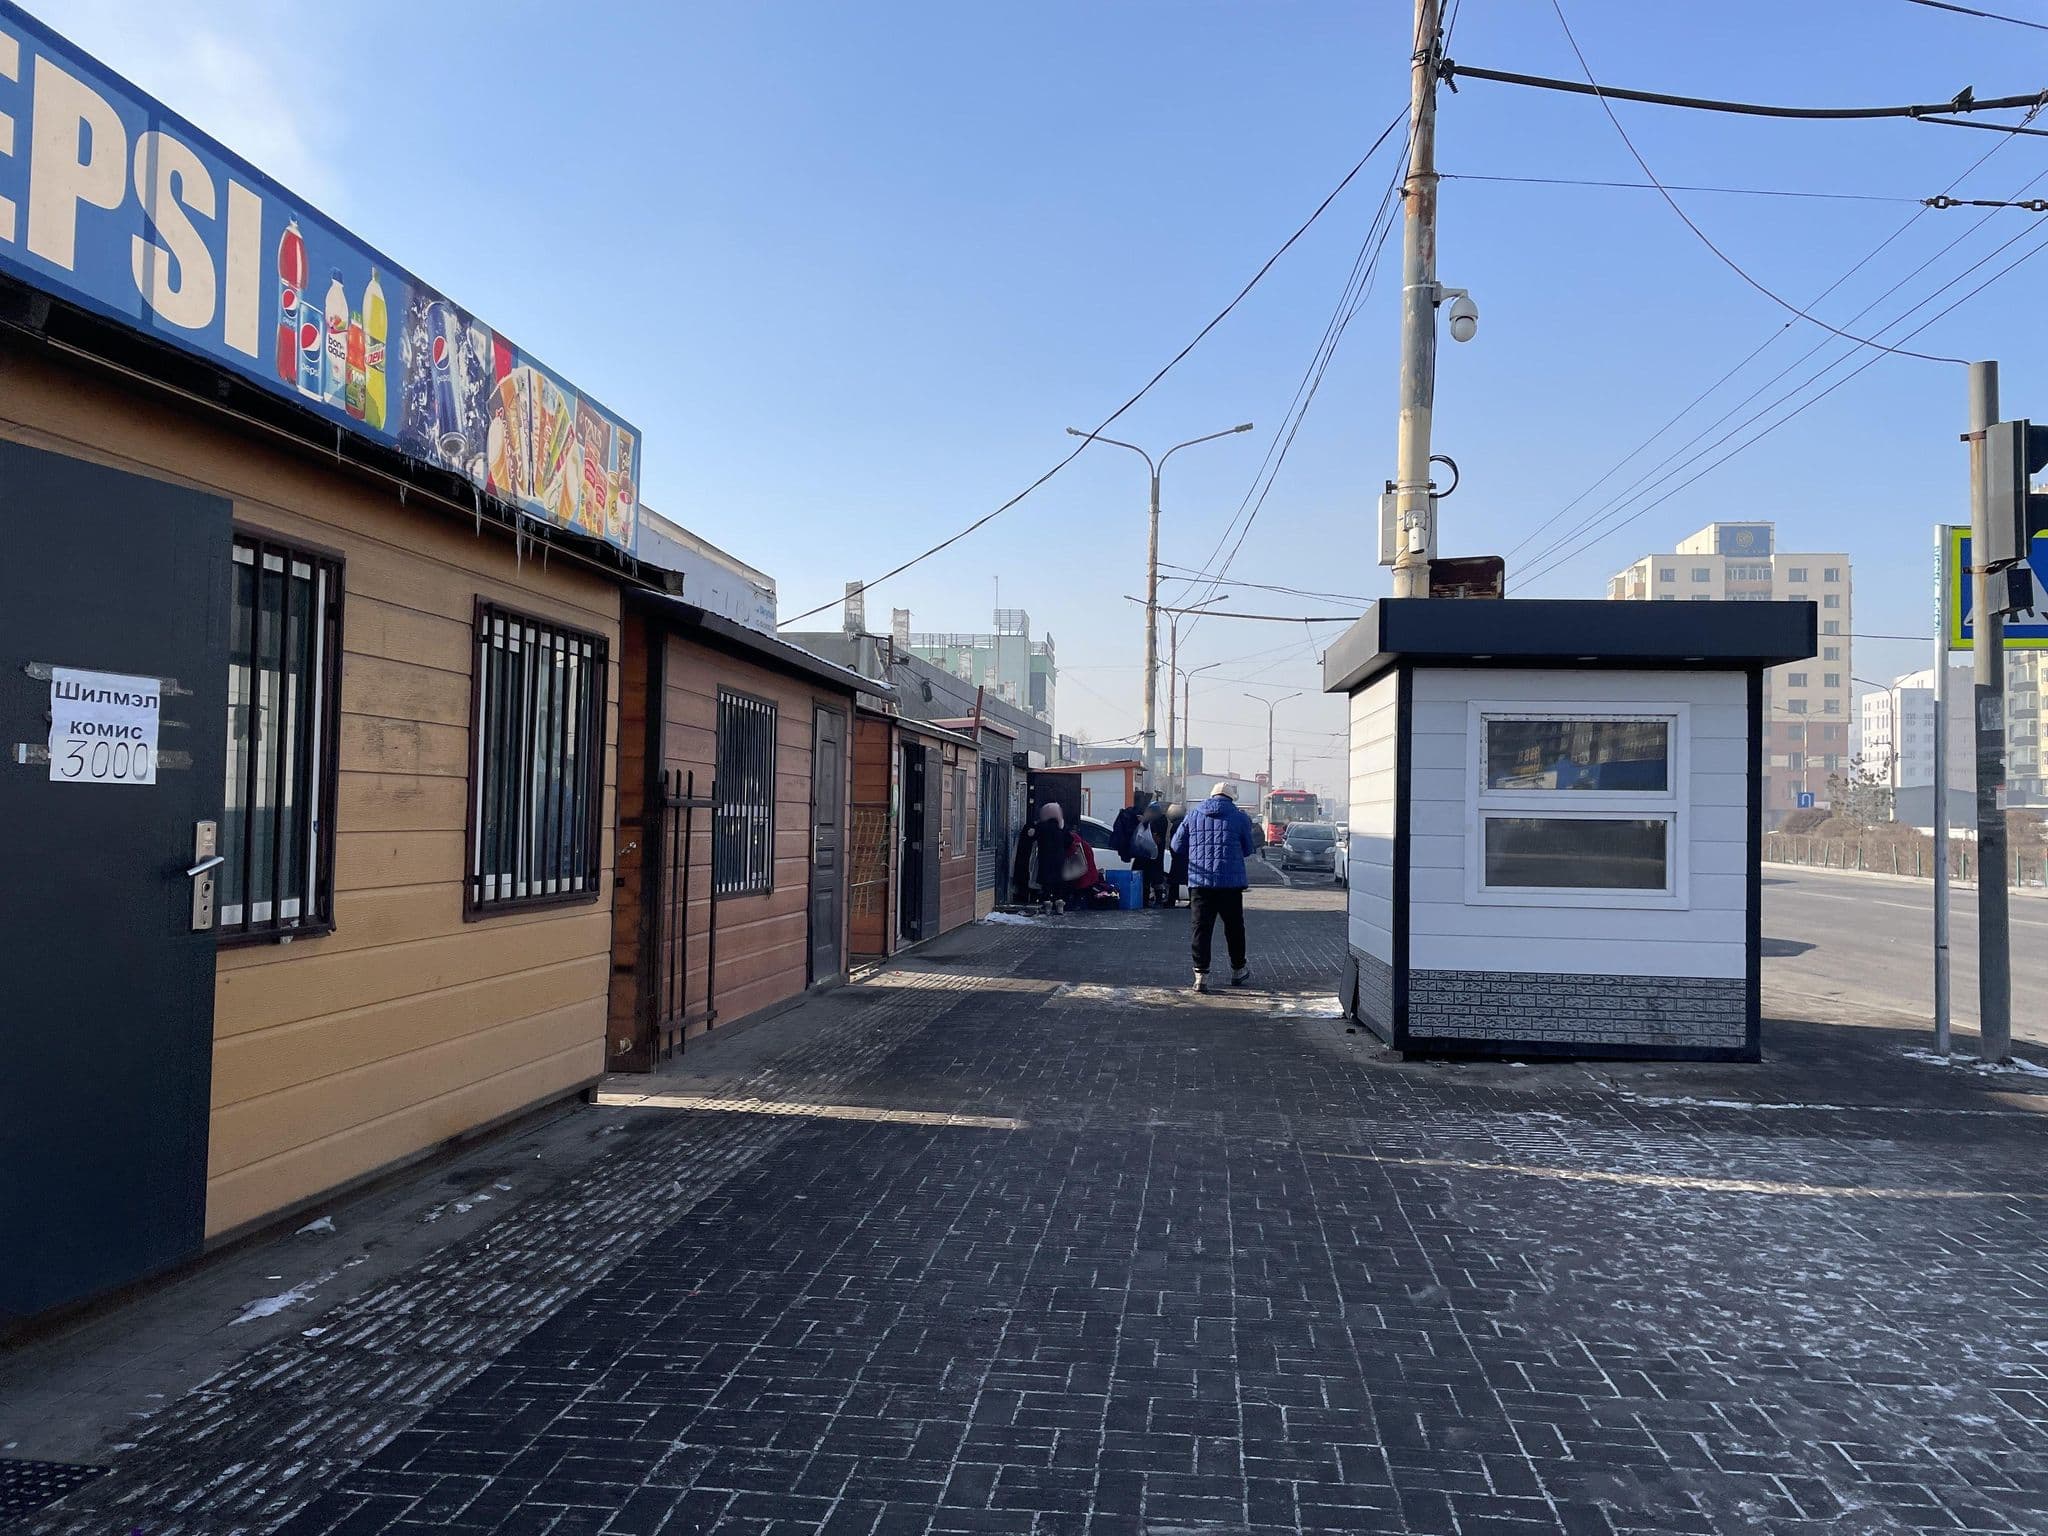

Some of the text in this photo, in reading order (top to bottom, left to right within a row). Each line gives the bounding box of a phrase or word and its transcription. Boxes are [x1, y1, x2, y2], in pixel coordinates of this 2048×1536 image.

[328, 345, 346, 360] aqua
[55, 680, 158, 709] Шилмэл
[70, 720, 143, 740] комис
[60, 739, 149, 781] 3000
